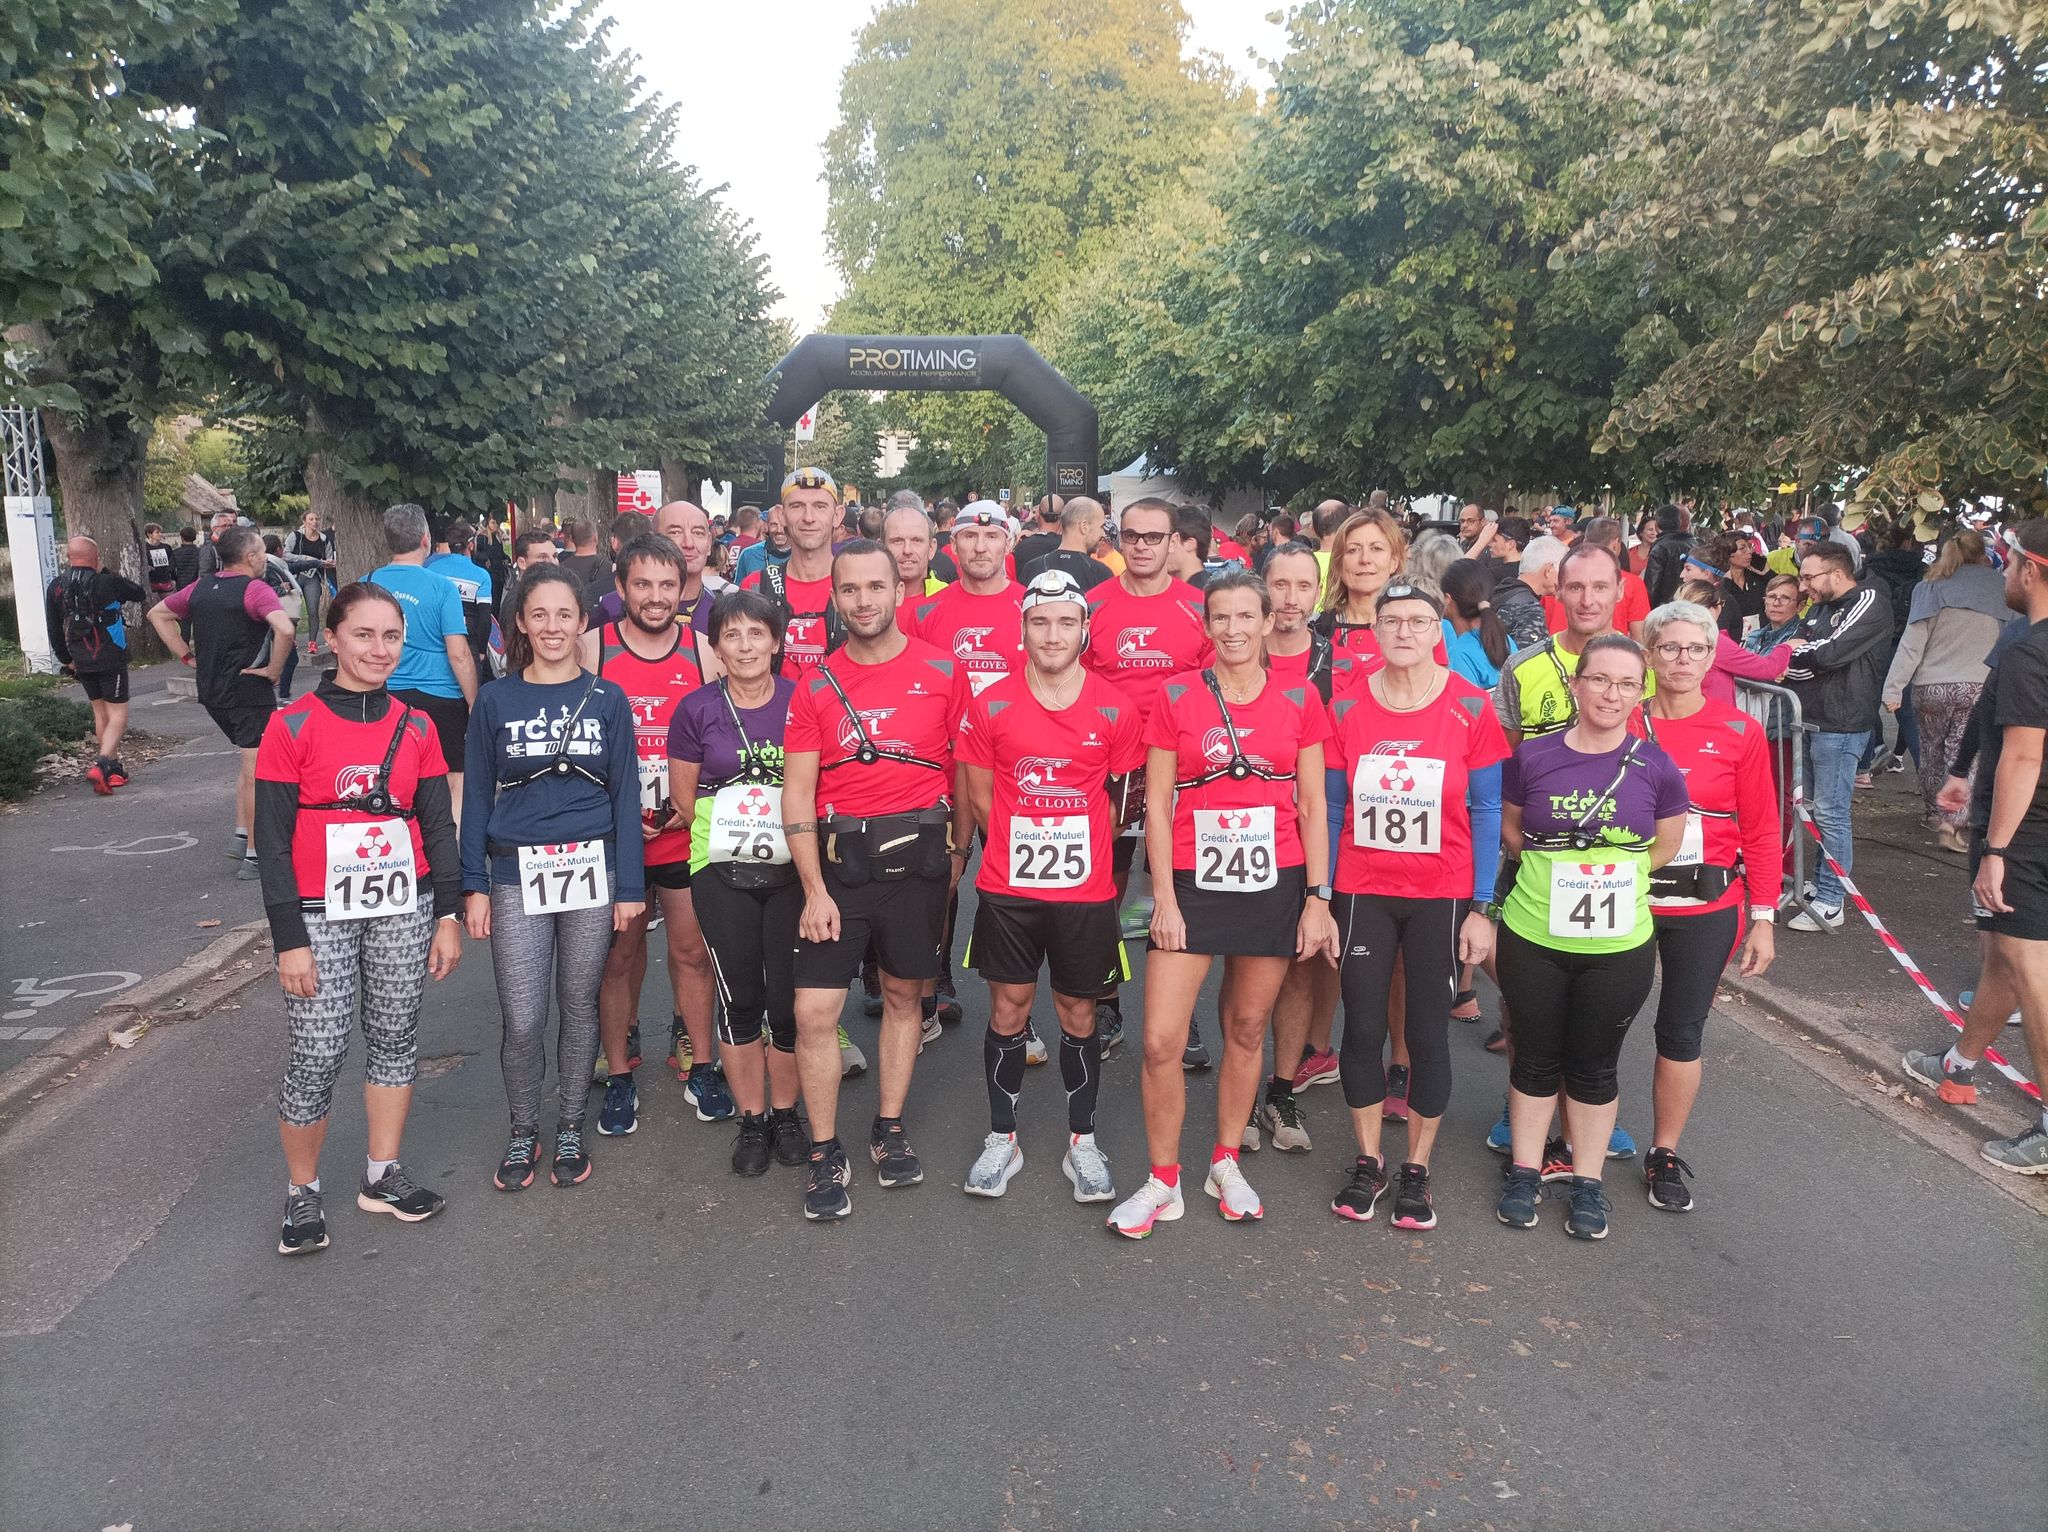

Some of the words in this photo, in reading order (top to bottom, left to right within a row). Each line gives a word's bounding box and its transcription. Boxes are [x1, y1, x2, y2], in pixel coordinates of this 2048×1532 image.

[850, 348, 977, 370] PROTIMING
[1060, 469, 1084, 479] PRO
[1060, 478, 1084, 486] TIMING
[968, 660, 1008, 669] CLOYES
[1117, 660, 1130, 669] AC
[1132, 660, 1174, 668] CLOYES
[637, 736, 668, 747] CLO
[640, 776, 662, 809] 1
[1016, 796, 1032, 807] AC
[1035, 797, 1088, 809] CLOYES
[1359, 793, 1388, 804] Crédit
[1401, 797, 1435, 808] Mutuel
[717, 817, 746, 827] Crédit
[1361, 806, 1429, 846] 181
[1015, 830, 1041, 841] Crédit
[1053, 831, 1085, 841] Mutuel
[1201, 833, 1228, 843] Crédit
[1240, 832, 1270, 843] Mutuel
[728, 830, 774, 861] 76
[333, 864, 366, 873] Crédit
[378, 858, 410, 870] Mutuel
[526, 861, 555, 870] Crédit
[567, 854, 600, 866] Mutuel
[1015, 843, 1086, 880] 225
[1201, 846, 1271, 884] 249
[334, 870, 410, 911] 150
[529, 866, 597, 907] 171
[1557, 878, 1589, 889] Crédit
[1602, 877, 1633, 890] Mutuel
[1568, 892, 1616, 930] 41
